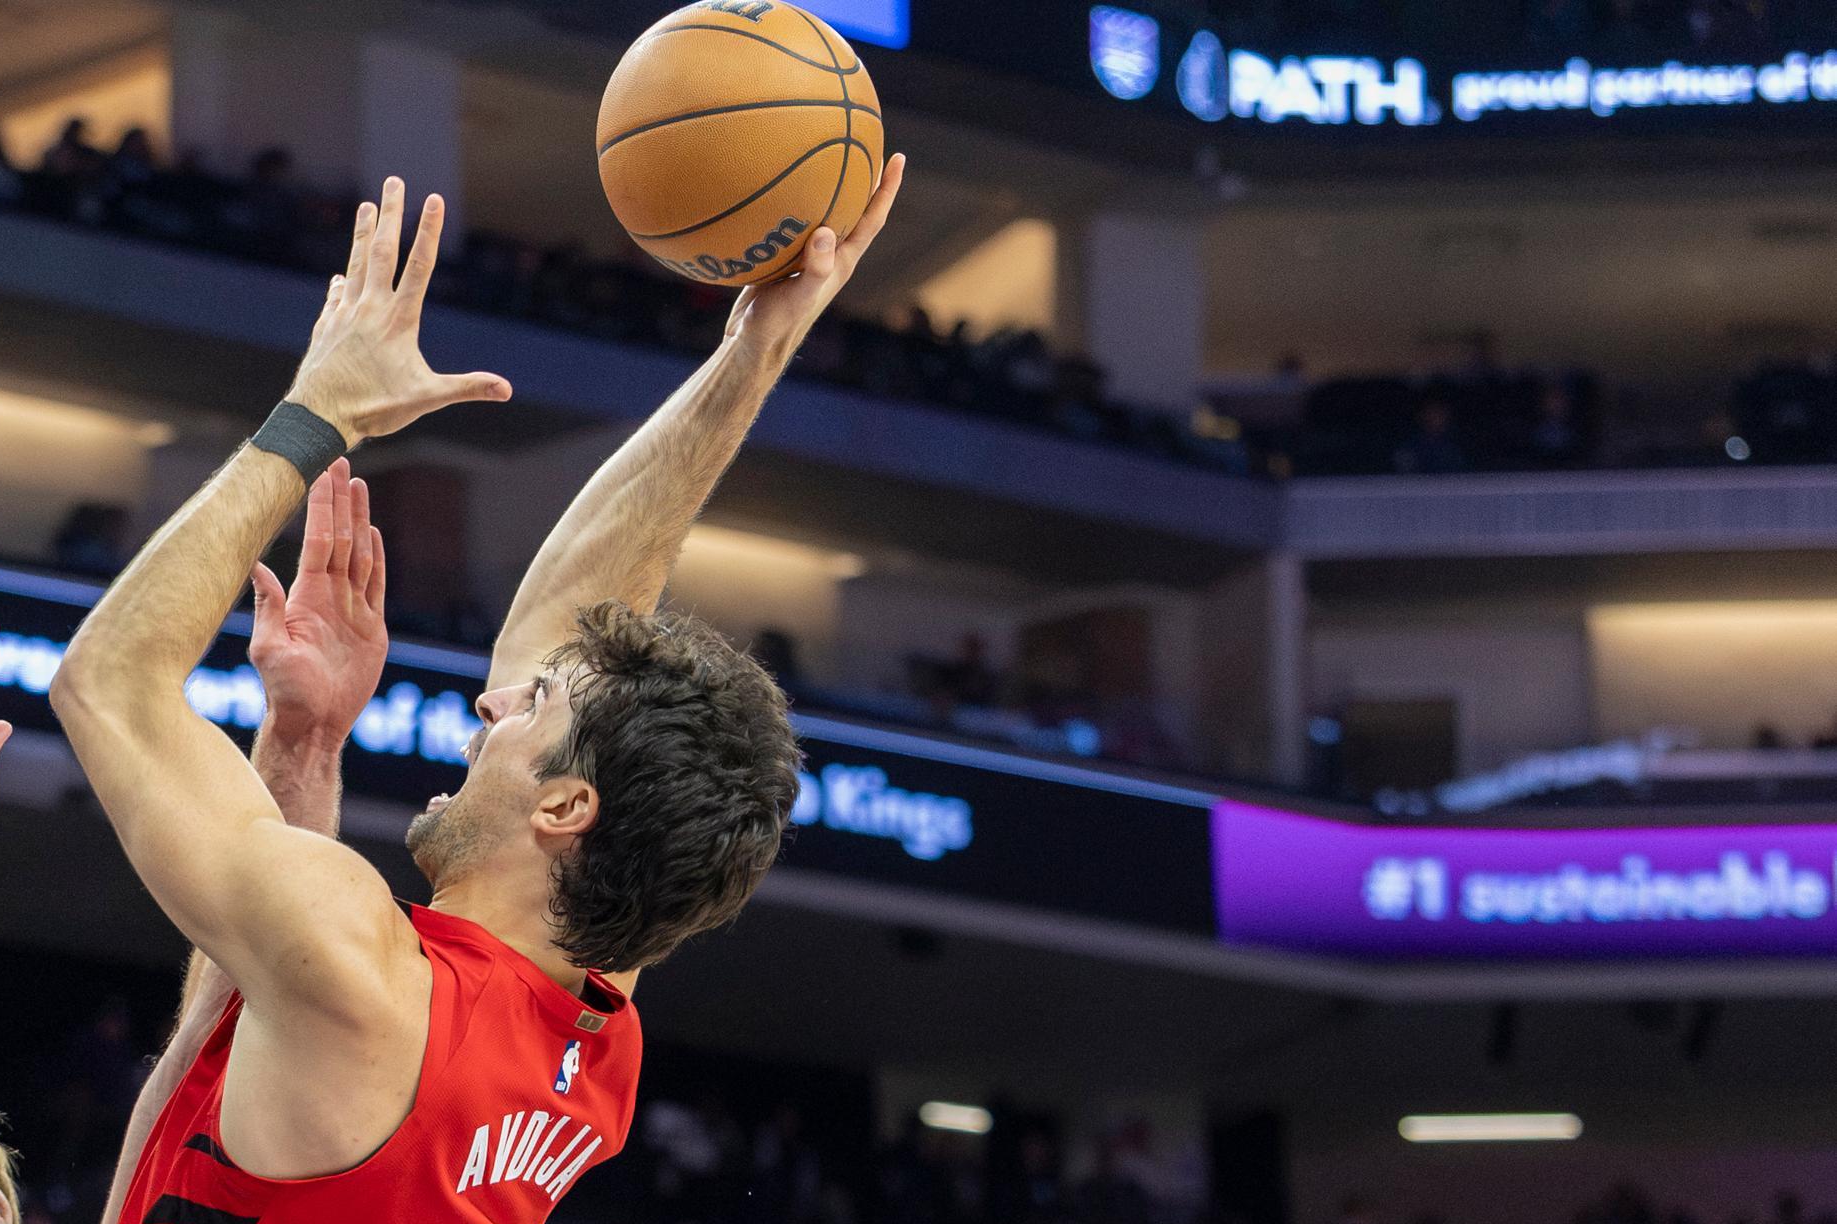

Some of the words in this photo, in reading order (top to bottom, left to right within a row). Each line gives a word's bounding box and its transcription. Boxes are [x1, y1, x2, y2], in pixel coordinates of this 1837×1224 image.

[1229, 49, 1425, 125] PATH
[821, 763, 974, 861] Kings
[1366, 855, 1449, 922] #1
[1461, 850, 1828, 923] sustainable
[456, 1110, 603, 1201] AVDIJA
